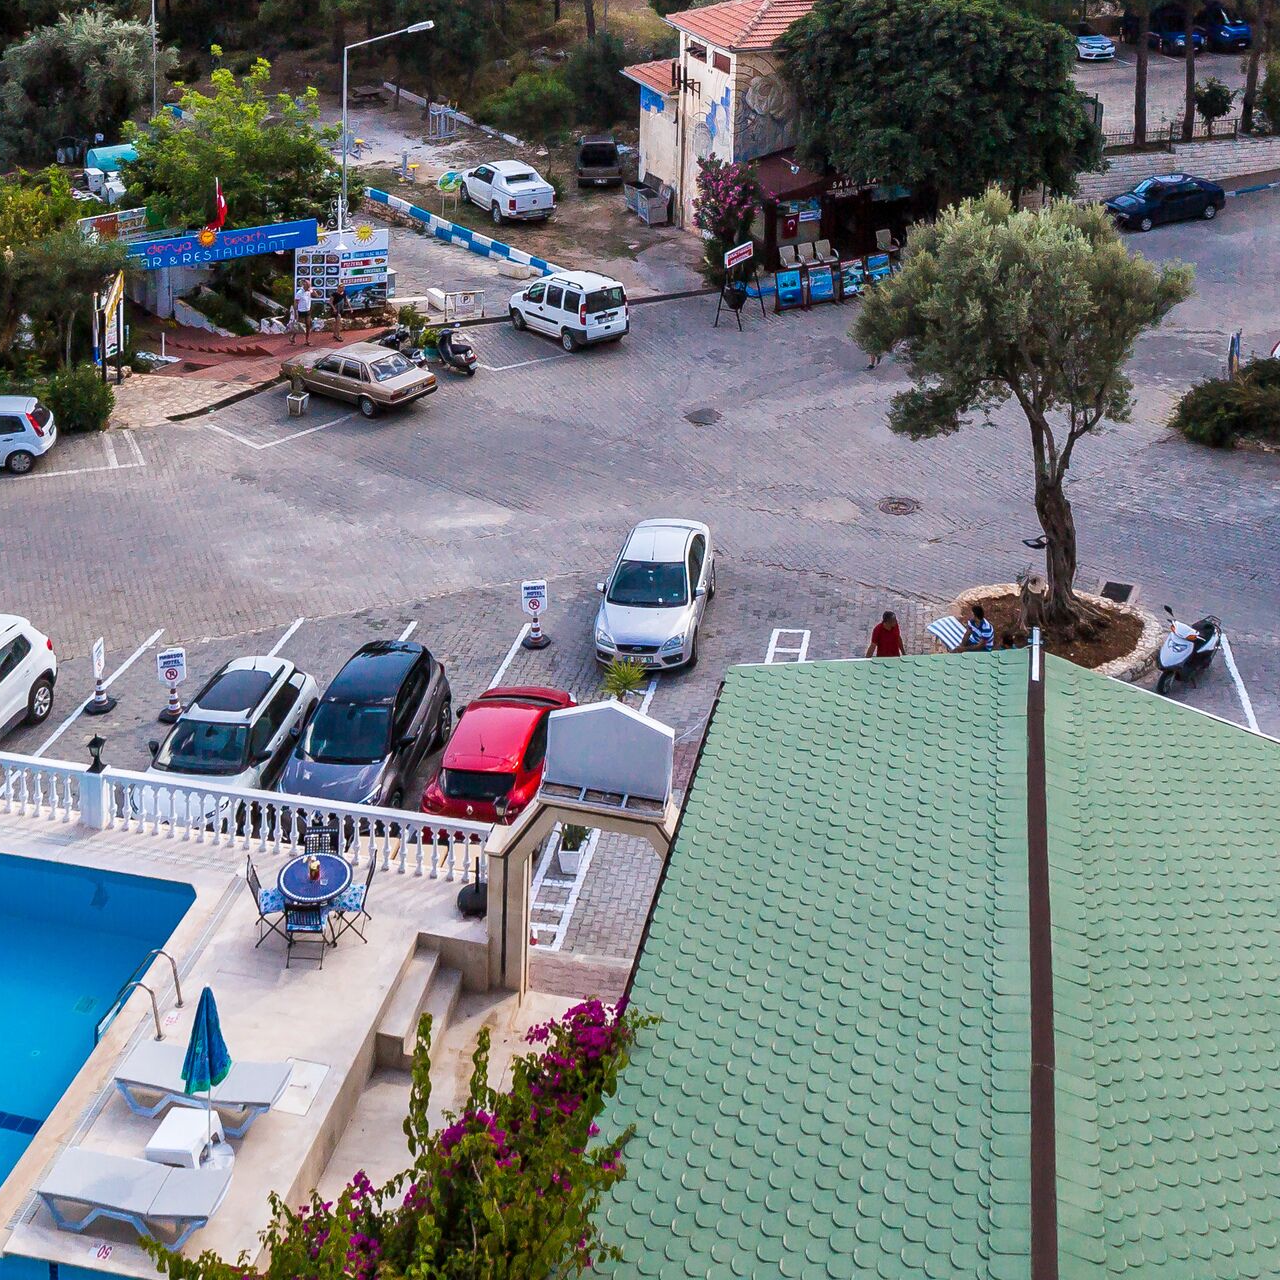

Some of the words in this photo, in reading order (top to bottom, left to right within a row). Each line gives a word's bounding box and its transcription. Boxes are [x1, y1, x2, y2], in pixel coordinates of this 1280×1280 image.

[832, 177, 877, 189] SAVOIA
[140, 256, 162, 268] AR
[169, 256, 178, 265] &
[182, 239, 286, 263] RESTAURANT
[146, 241, 193, 255] derya
[223, 230, 266, 246] beach
